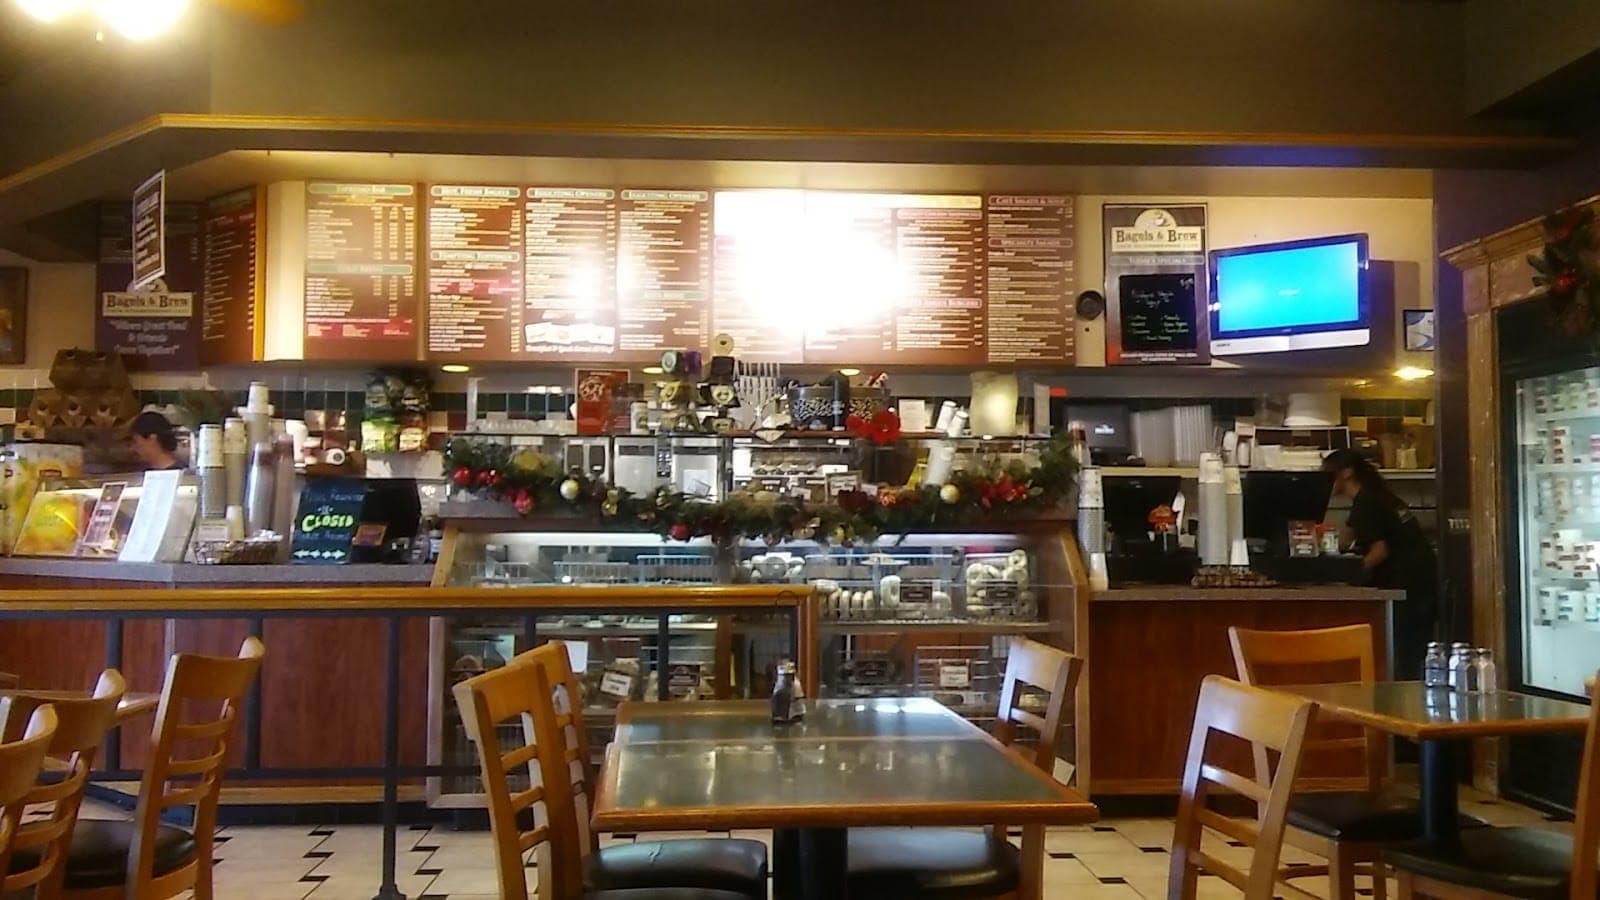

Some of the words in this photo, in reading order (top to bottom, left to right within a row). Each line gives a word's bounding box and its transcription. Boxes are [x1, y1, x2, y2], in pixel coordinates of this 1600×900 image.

[1116, 229, 1154, 243] Bagels
[1156, 231, 1164, 240] &
[1167, 229, 1199, 242] Brew
[107, 295, 145, 309] Bagels
[159, 295, 188, 308] Brew
[302, 514, 354, 532] CLOSED
